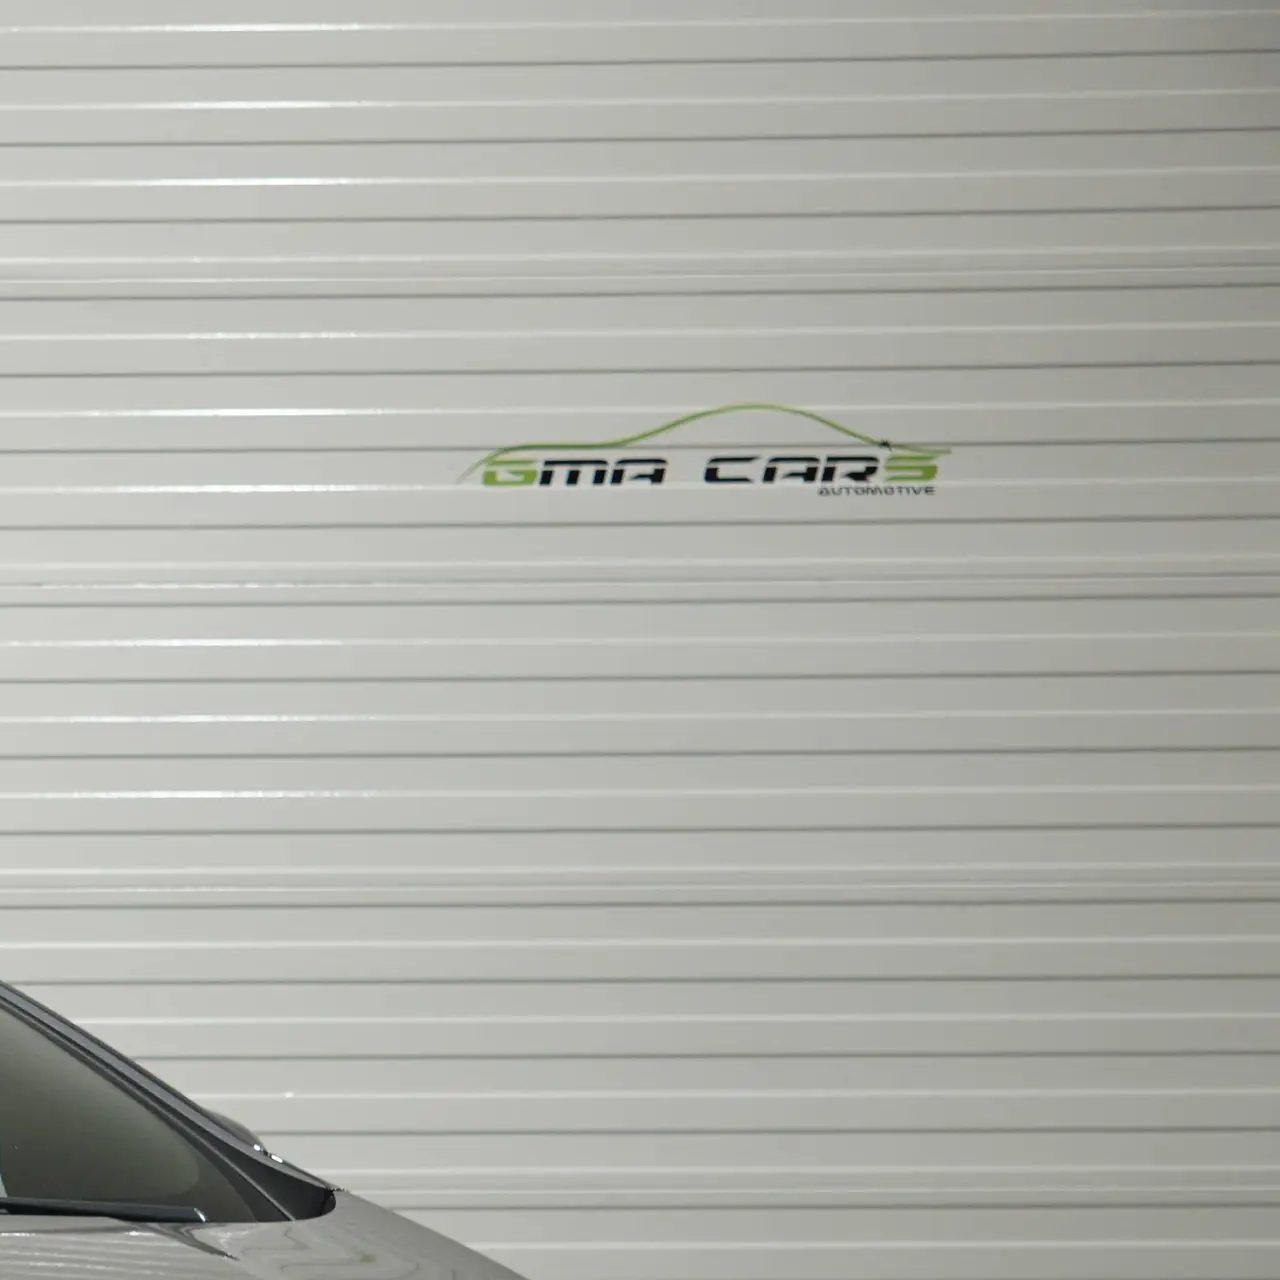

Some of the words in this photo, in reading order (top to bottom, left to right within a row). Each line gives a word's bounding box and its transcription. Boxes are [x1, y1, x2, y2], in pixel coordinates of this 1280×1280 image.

[481, 457, 669, 487] GMA
[704, 454, 938, 485] CARS
[818, 485, 936, 496] AUTOMOTIVE
